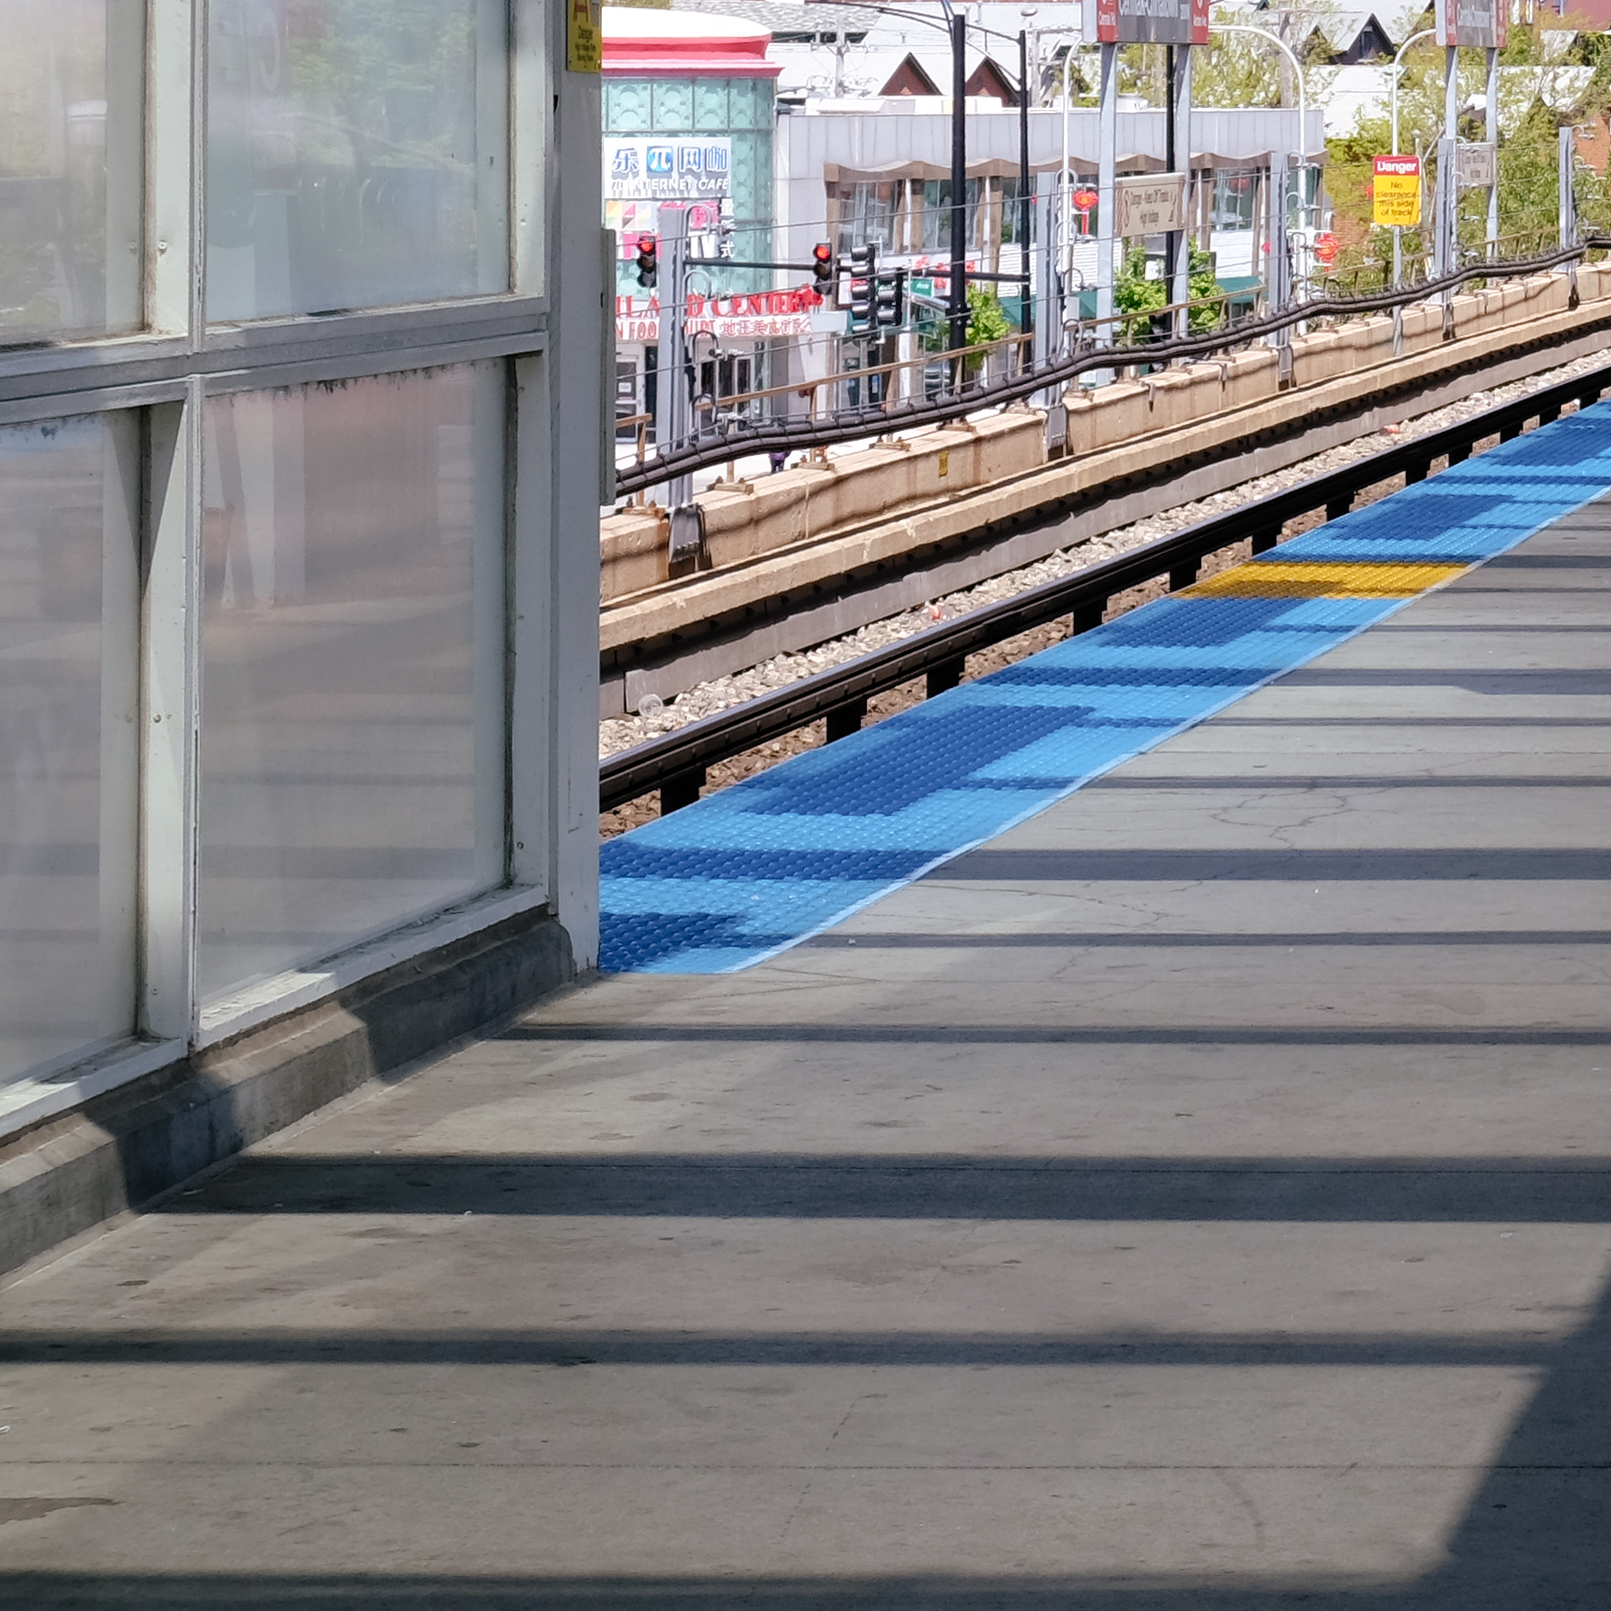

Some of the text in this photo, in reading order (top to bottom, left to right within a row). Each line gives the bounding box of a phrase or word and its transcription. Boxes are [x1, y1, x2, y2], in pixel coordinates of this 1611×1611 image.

[1377, 161, 1417, 175] Danger
[628, 178, 693, 191] INTERNET
[697, 178, 728, 191] CAFE
[1390, 181, 1403, 189] No
